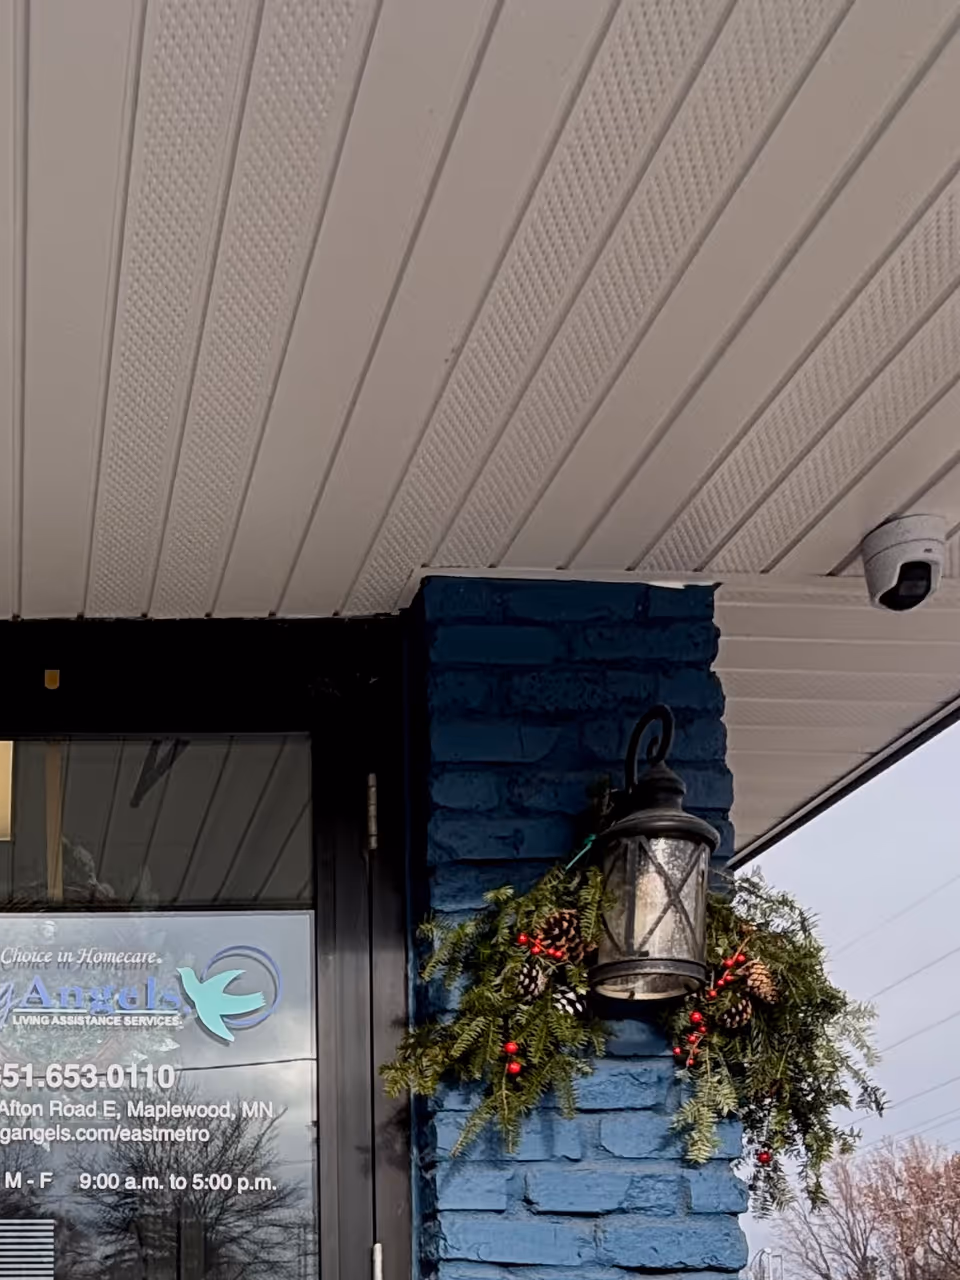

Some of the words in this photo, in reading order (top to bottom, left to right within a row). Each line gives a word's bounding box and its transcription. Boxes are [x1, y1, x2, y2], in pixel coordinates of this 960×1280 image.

[0, 946, 53, 965] Choice
[57, 947, 73, 964] in
[12, 1015, 51, 1026] LIVING
[51, 1015, 122, 1026] ASSISTANCE
[49, 1100, 97, 1118] Road
[103, 1101, 122, 1120] E,
[127, 1101, 236, 1121] Maplewood,
[242, 1101, 273, 1118] MN
[5, 1171, 23, 1188] M
[40, 1172, 53, 1189] F
[79, 1172, 120, 1190] 9:00
[124, 1176, 164, 1190] a.m.
[169, 1174, 188, 1190] to
[191, 1173, 233, 1190] 5:00
[237, 1176, 277, 1194] p.m.
